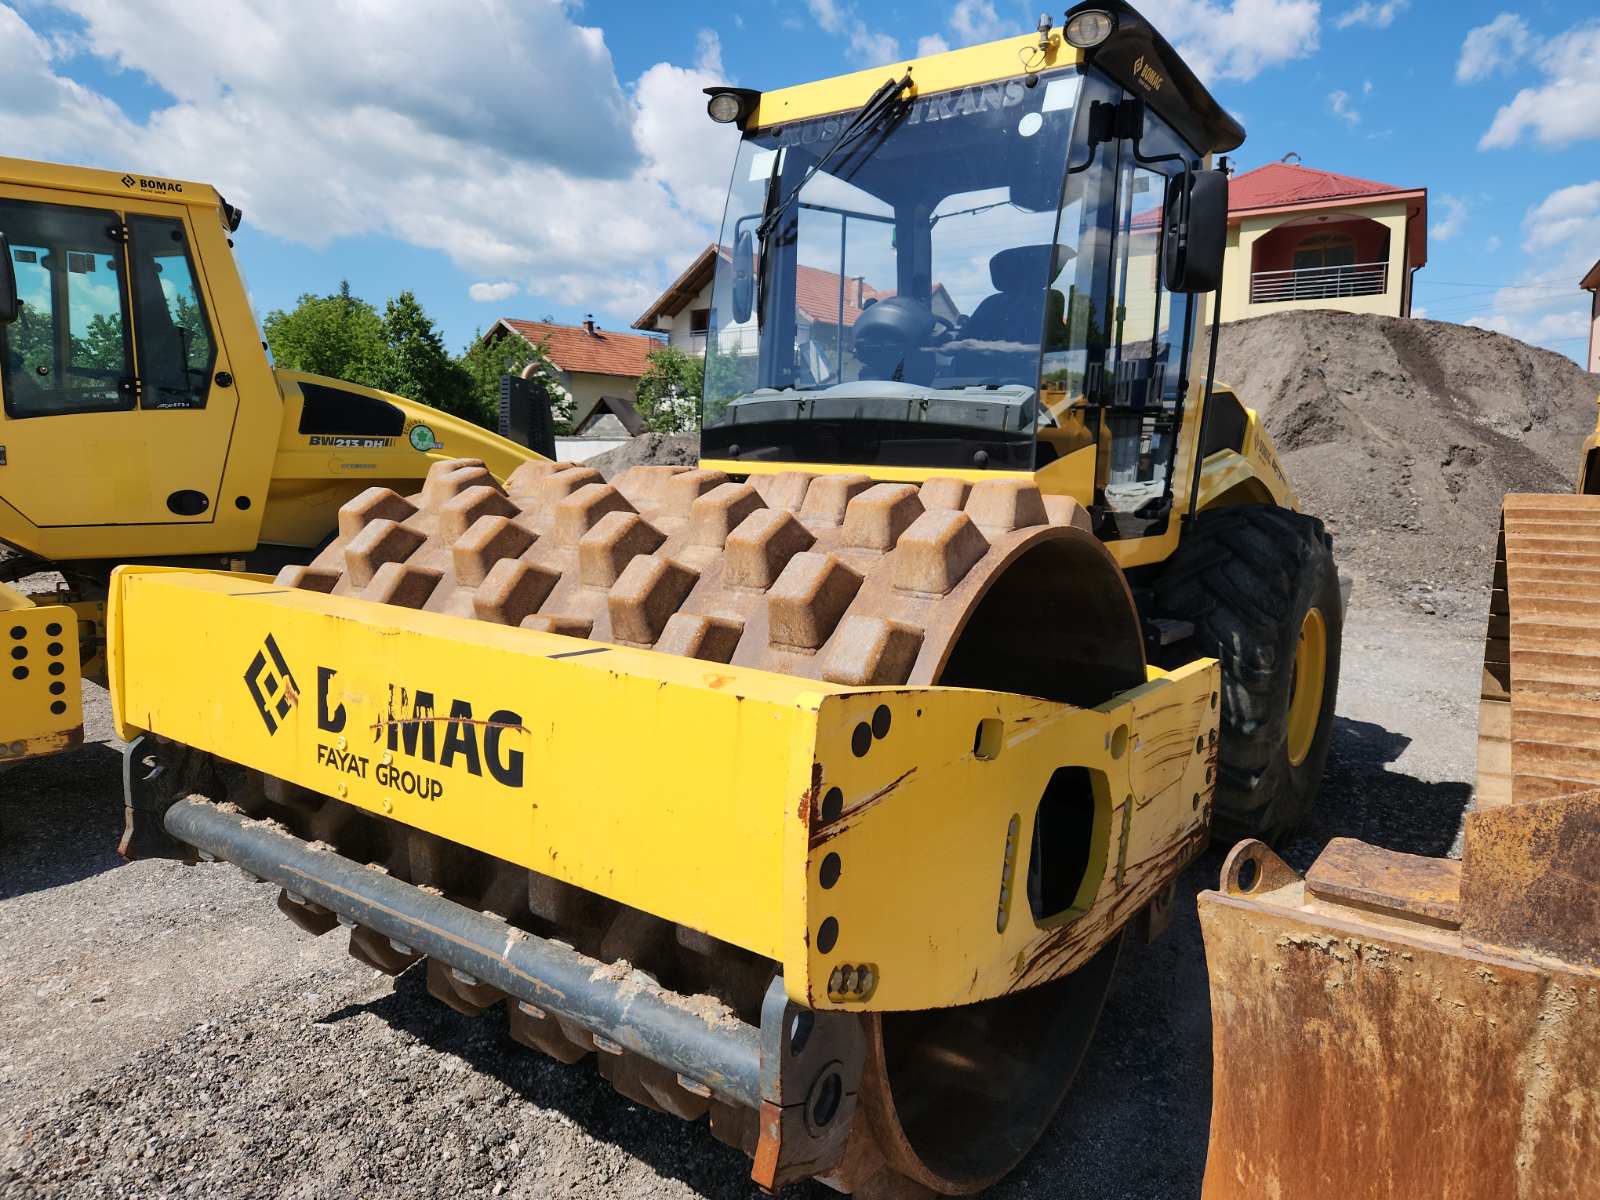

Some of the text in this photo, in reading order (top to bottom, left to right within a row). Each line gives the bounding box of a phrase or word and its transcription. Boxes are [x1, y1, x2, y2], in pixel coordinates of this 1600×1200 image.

[1140, 63, 1164, 91] BOMAG
[140, 179, 183, 193] BOMAG
[317, 665, 524, 788] BMAG
[317, 743, 443, 801] FAYAT GROUP
